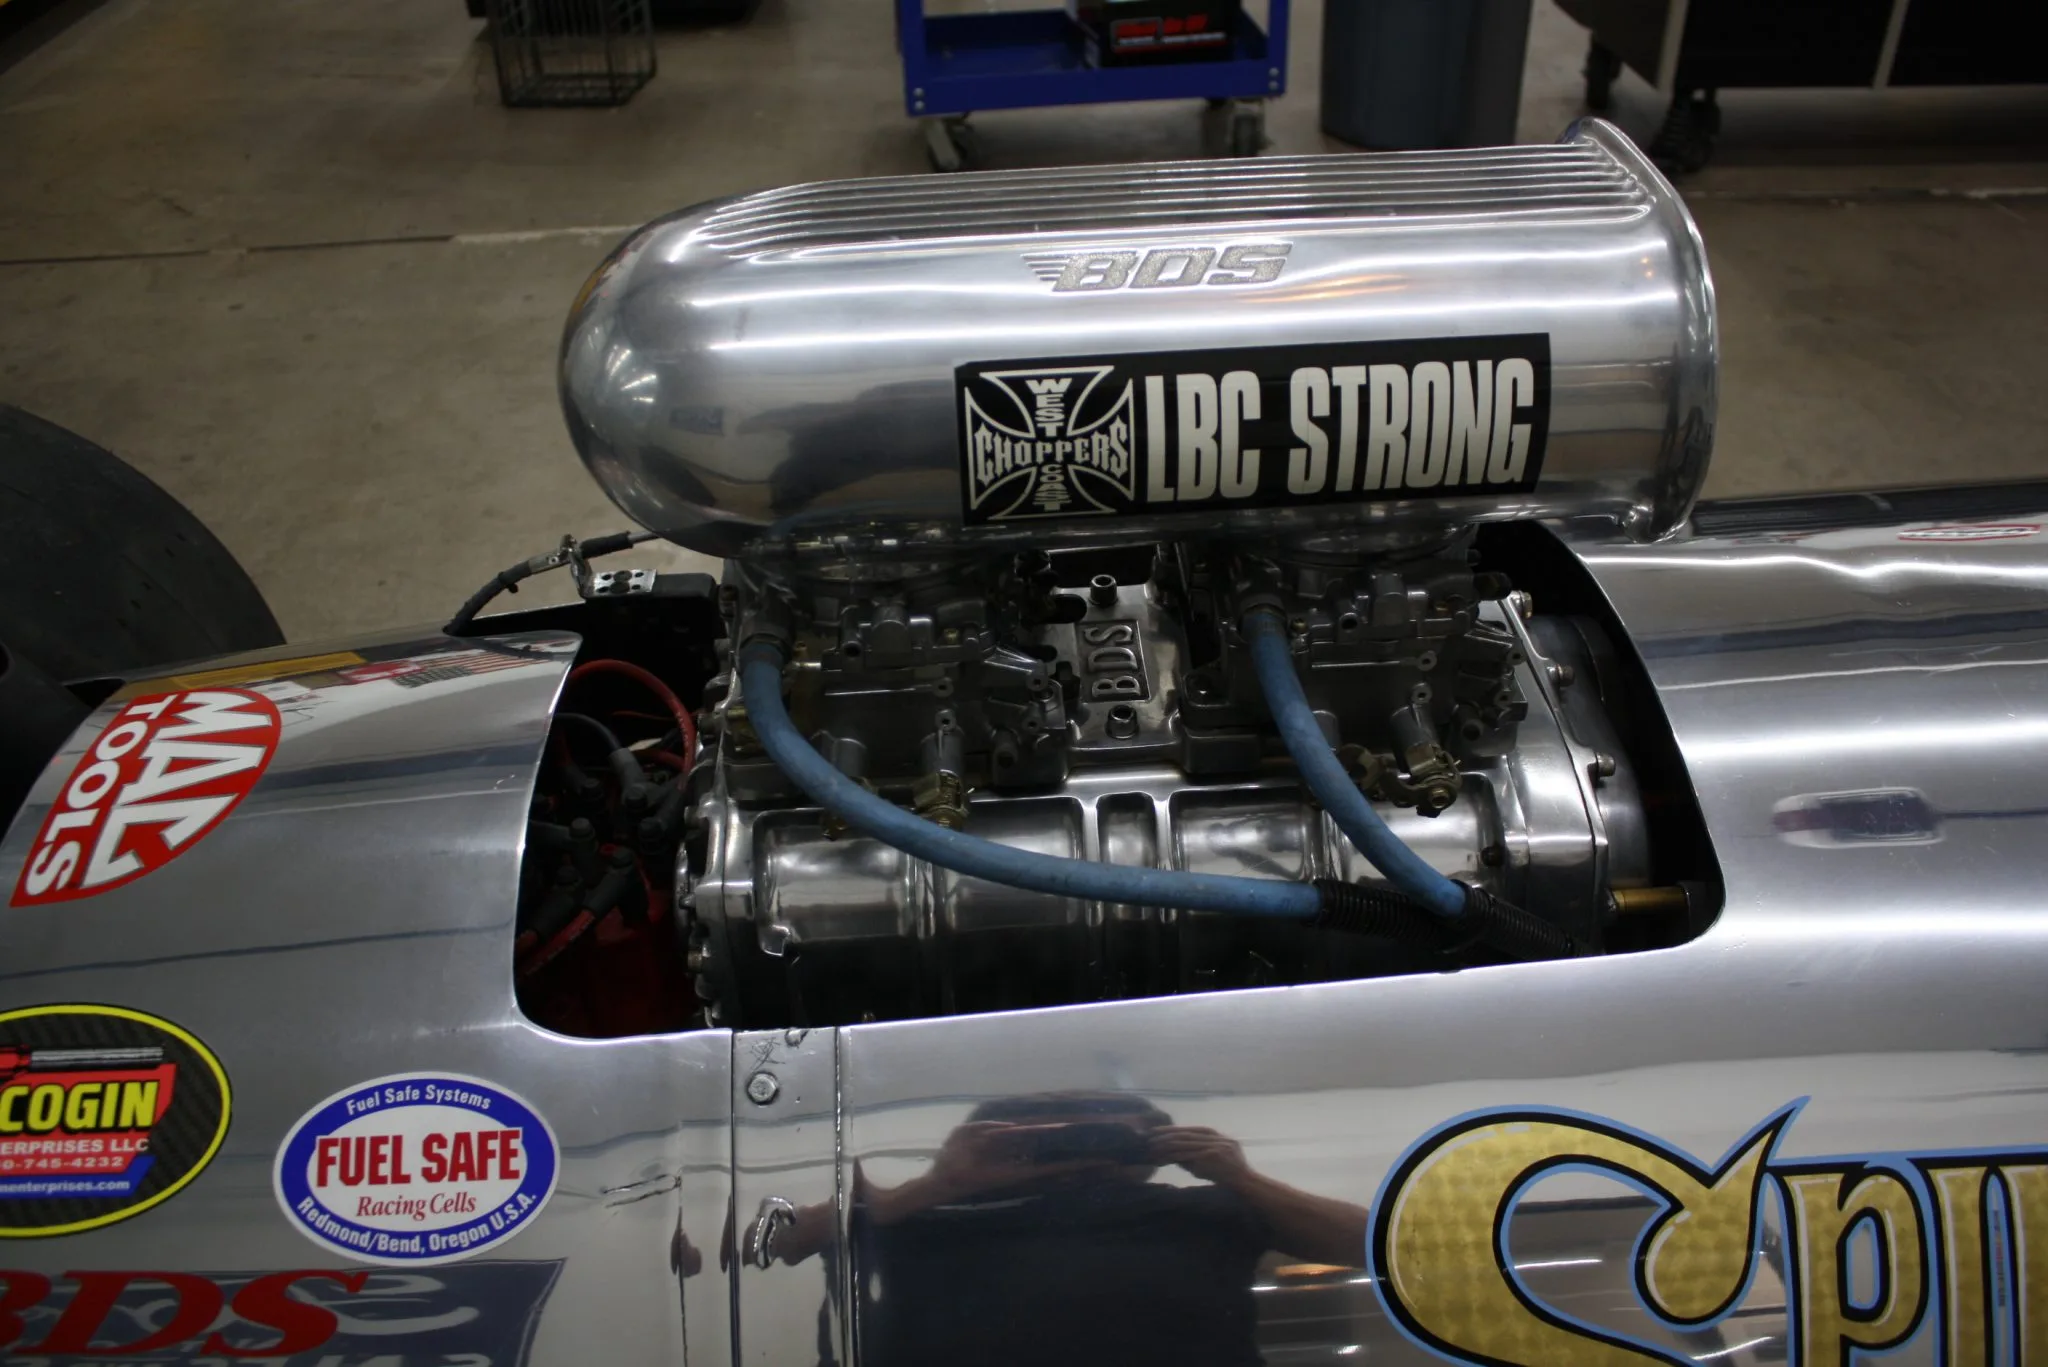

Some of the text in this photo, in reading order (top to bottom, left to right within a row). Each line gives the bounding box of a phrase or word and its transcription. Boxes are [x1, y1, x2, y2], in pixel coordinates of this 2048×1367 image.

[1051, 243, 1293, 292] BDS
[1025, 378, 1073, 437] WEST
[1145, 357, 1535, 502] LBC STRONG
[974, 415, 1129, 487] CHOPPERS
[1032, 464, 1073, 511] COAST
[1083, 624, 1142, 698] BDS
[25, 694, 179, 896] TOOLS
[80, 689, 275, 890] MAC
[346, 1084, 492, 1116] Fuel Safe Systems
[110, 1137, 149, 1152] LLC
[316, 1130, 521, 1188] FUEL SAFE
[356, 1191, 477, 1222] Racing Cells
[429, 1225, 491, 1252] Oregon
[490, 1193, 538, 1231] U.S.A.
